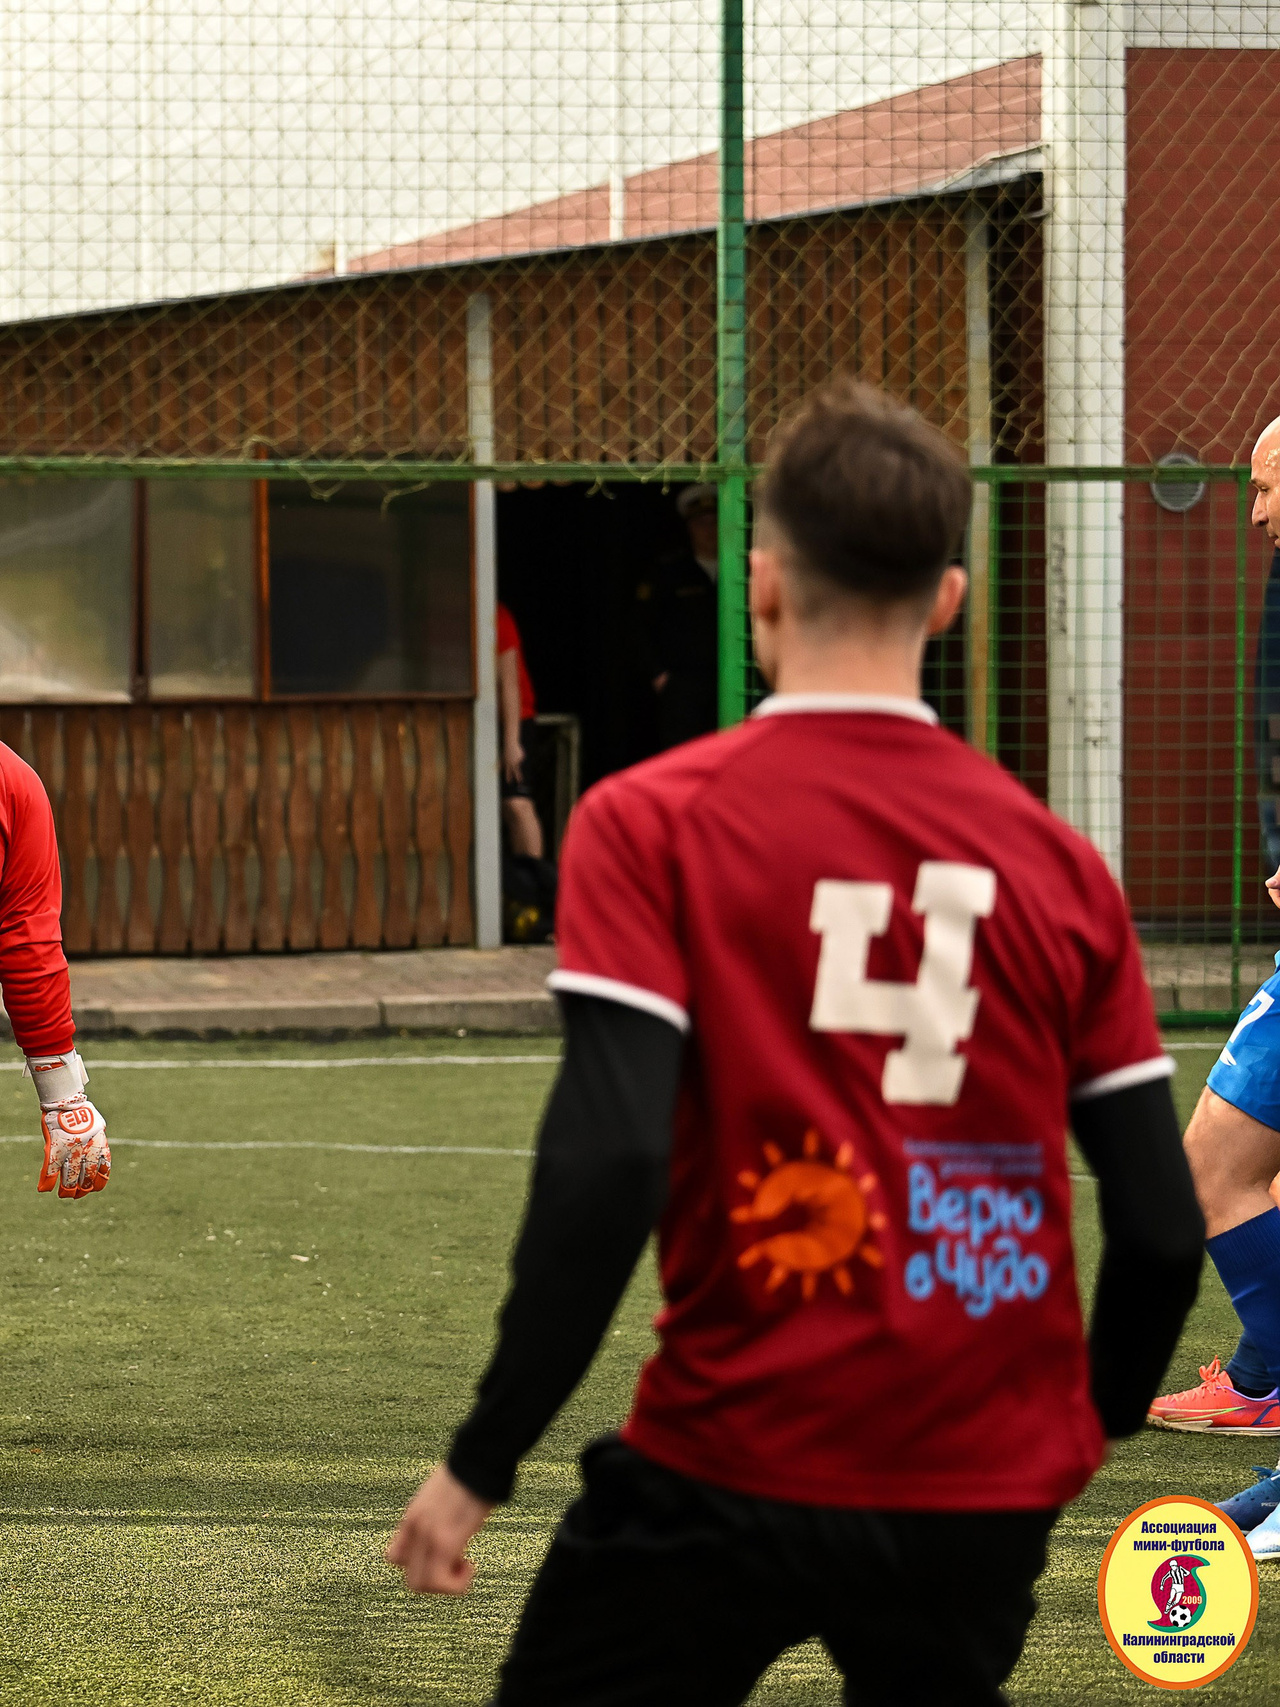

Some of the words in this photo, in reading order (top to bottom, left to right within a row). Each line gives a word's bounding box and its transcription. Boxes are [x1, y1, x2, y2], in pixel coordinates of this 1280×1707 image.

[809, 860, 997, 1106] 4
[907, 1161, 1042, 1249] Верю
[905, 1252, 934, 1300] в
